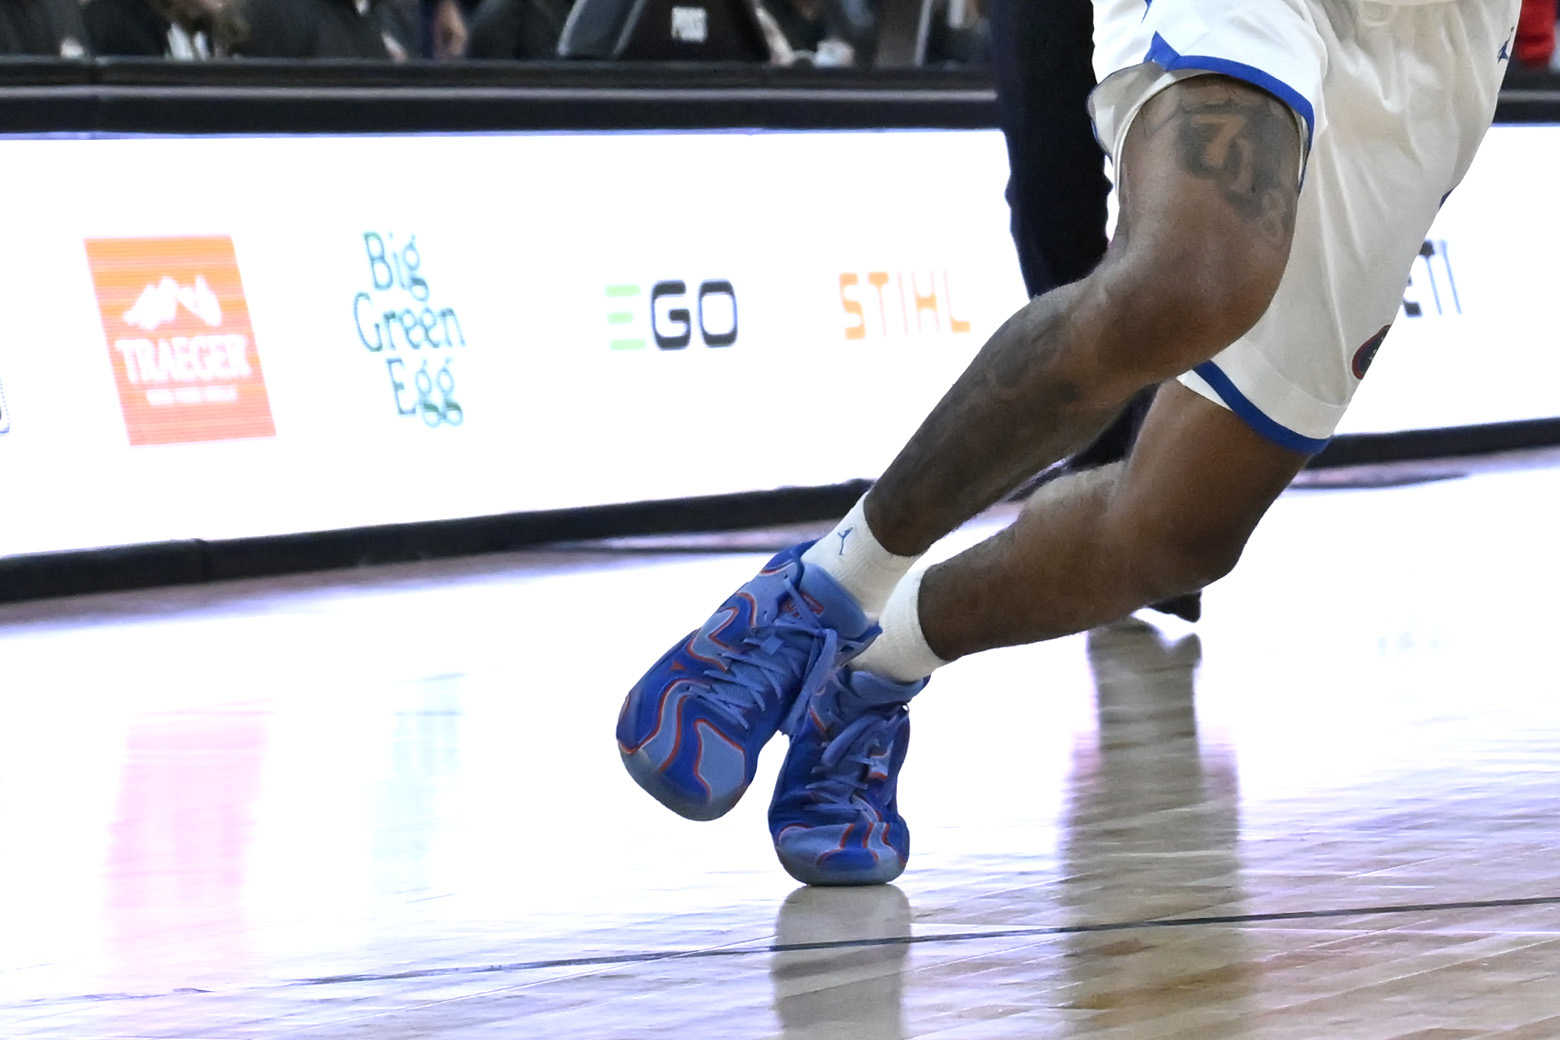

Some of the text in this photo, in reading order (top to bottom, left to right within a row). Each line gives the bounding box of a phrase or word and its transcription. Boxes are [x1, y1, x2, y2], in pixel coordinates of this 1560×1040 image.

[362, 231, 430, 302] Big
[353, 291, 466, 355] Green
[605, 279, 738, 351] EGO
[838, 269, 971, 340] STIHL
[115, 334, 252, 385] TRAEGER
[387, 356, 464, 428] Egg
